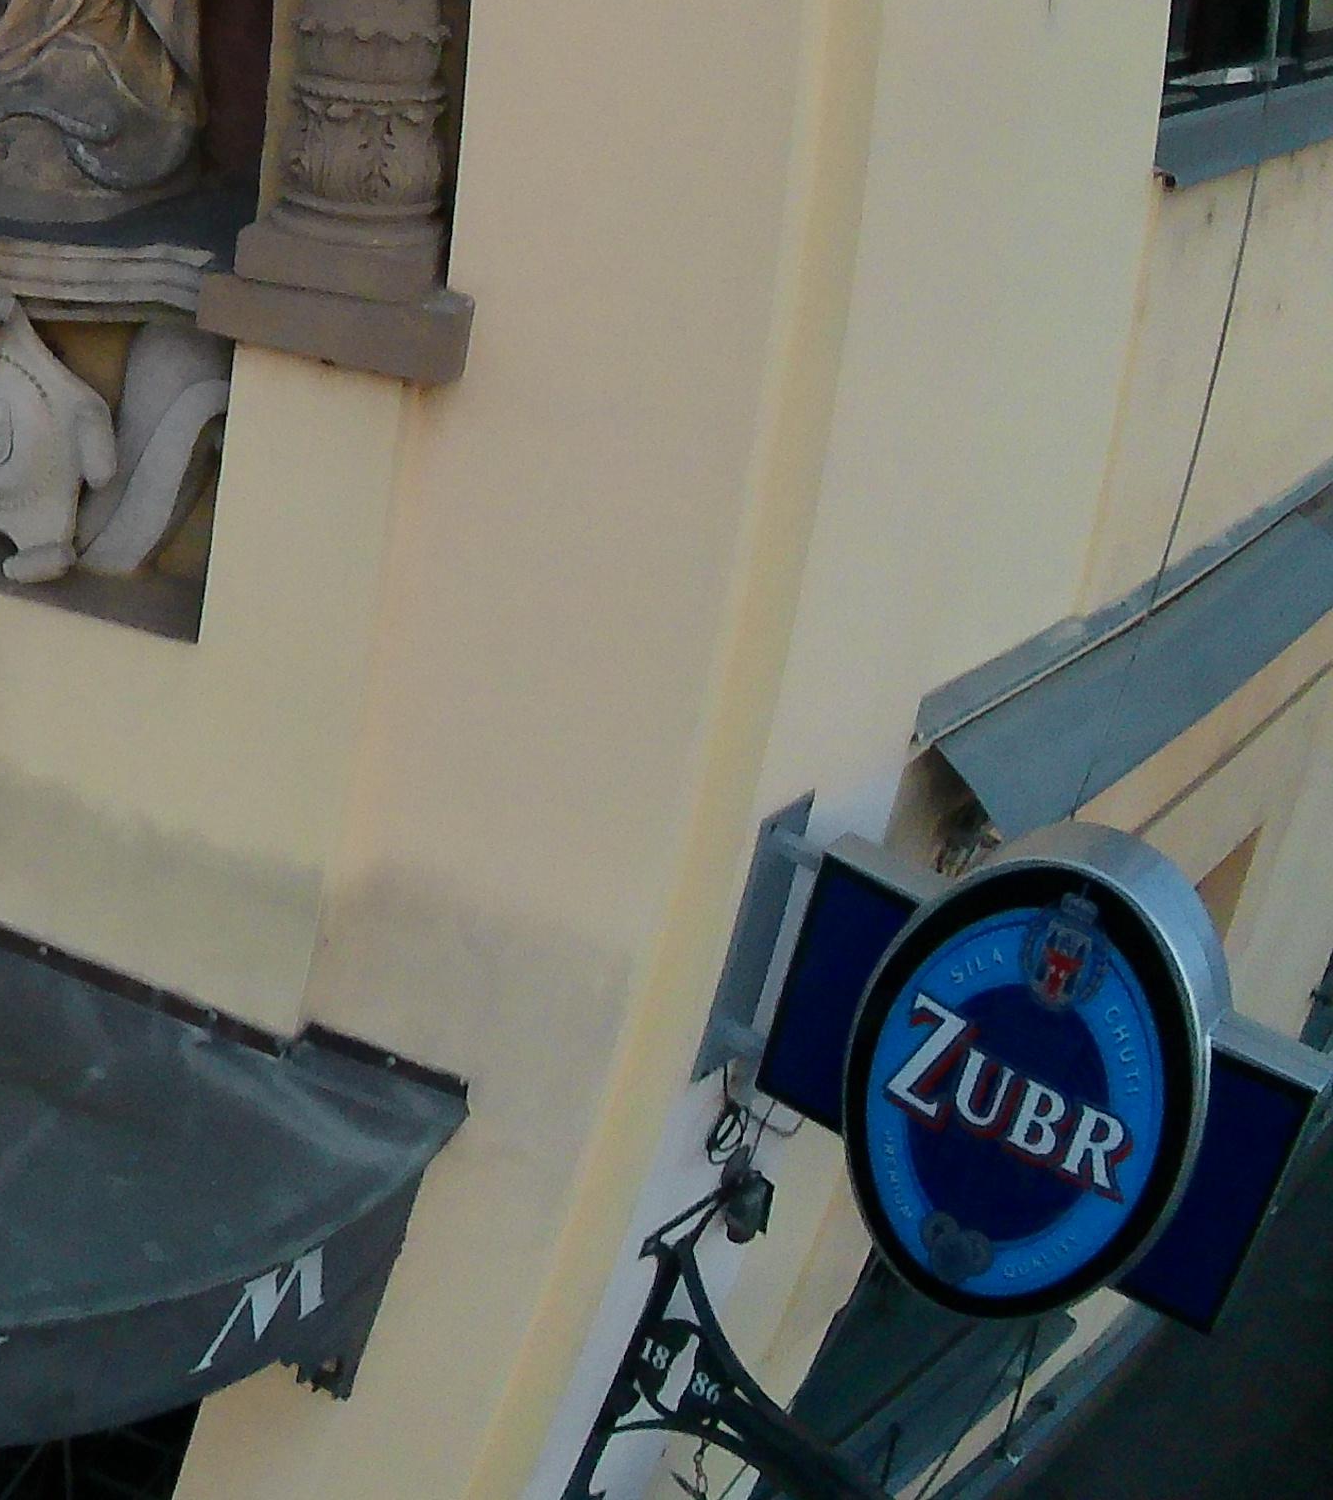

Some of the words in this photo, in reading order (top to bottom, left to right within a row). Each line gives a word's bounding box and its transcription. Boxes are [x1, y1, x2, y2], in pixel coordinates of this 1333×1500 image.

[887, 993, 1126, 1190] ZUBR
[641, 1337, 670, 1370] 18
[691, 1371, 720, 1404] 86
